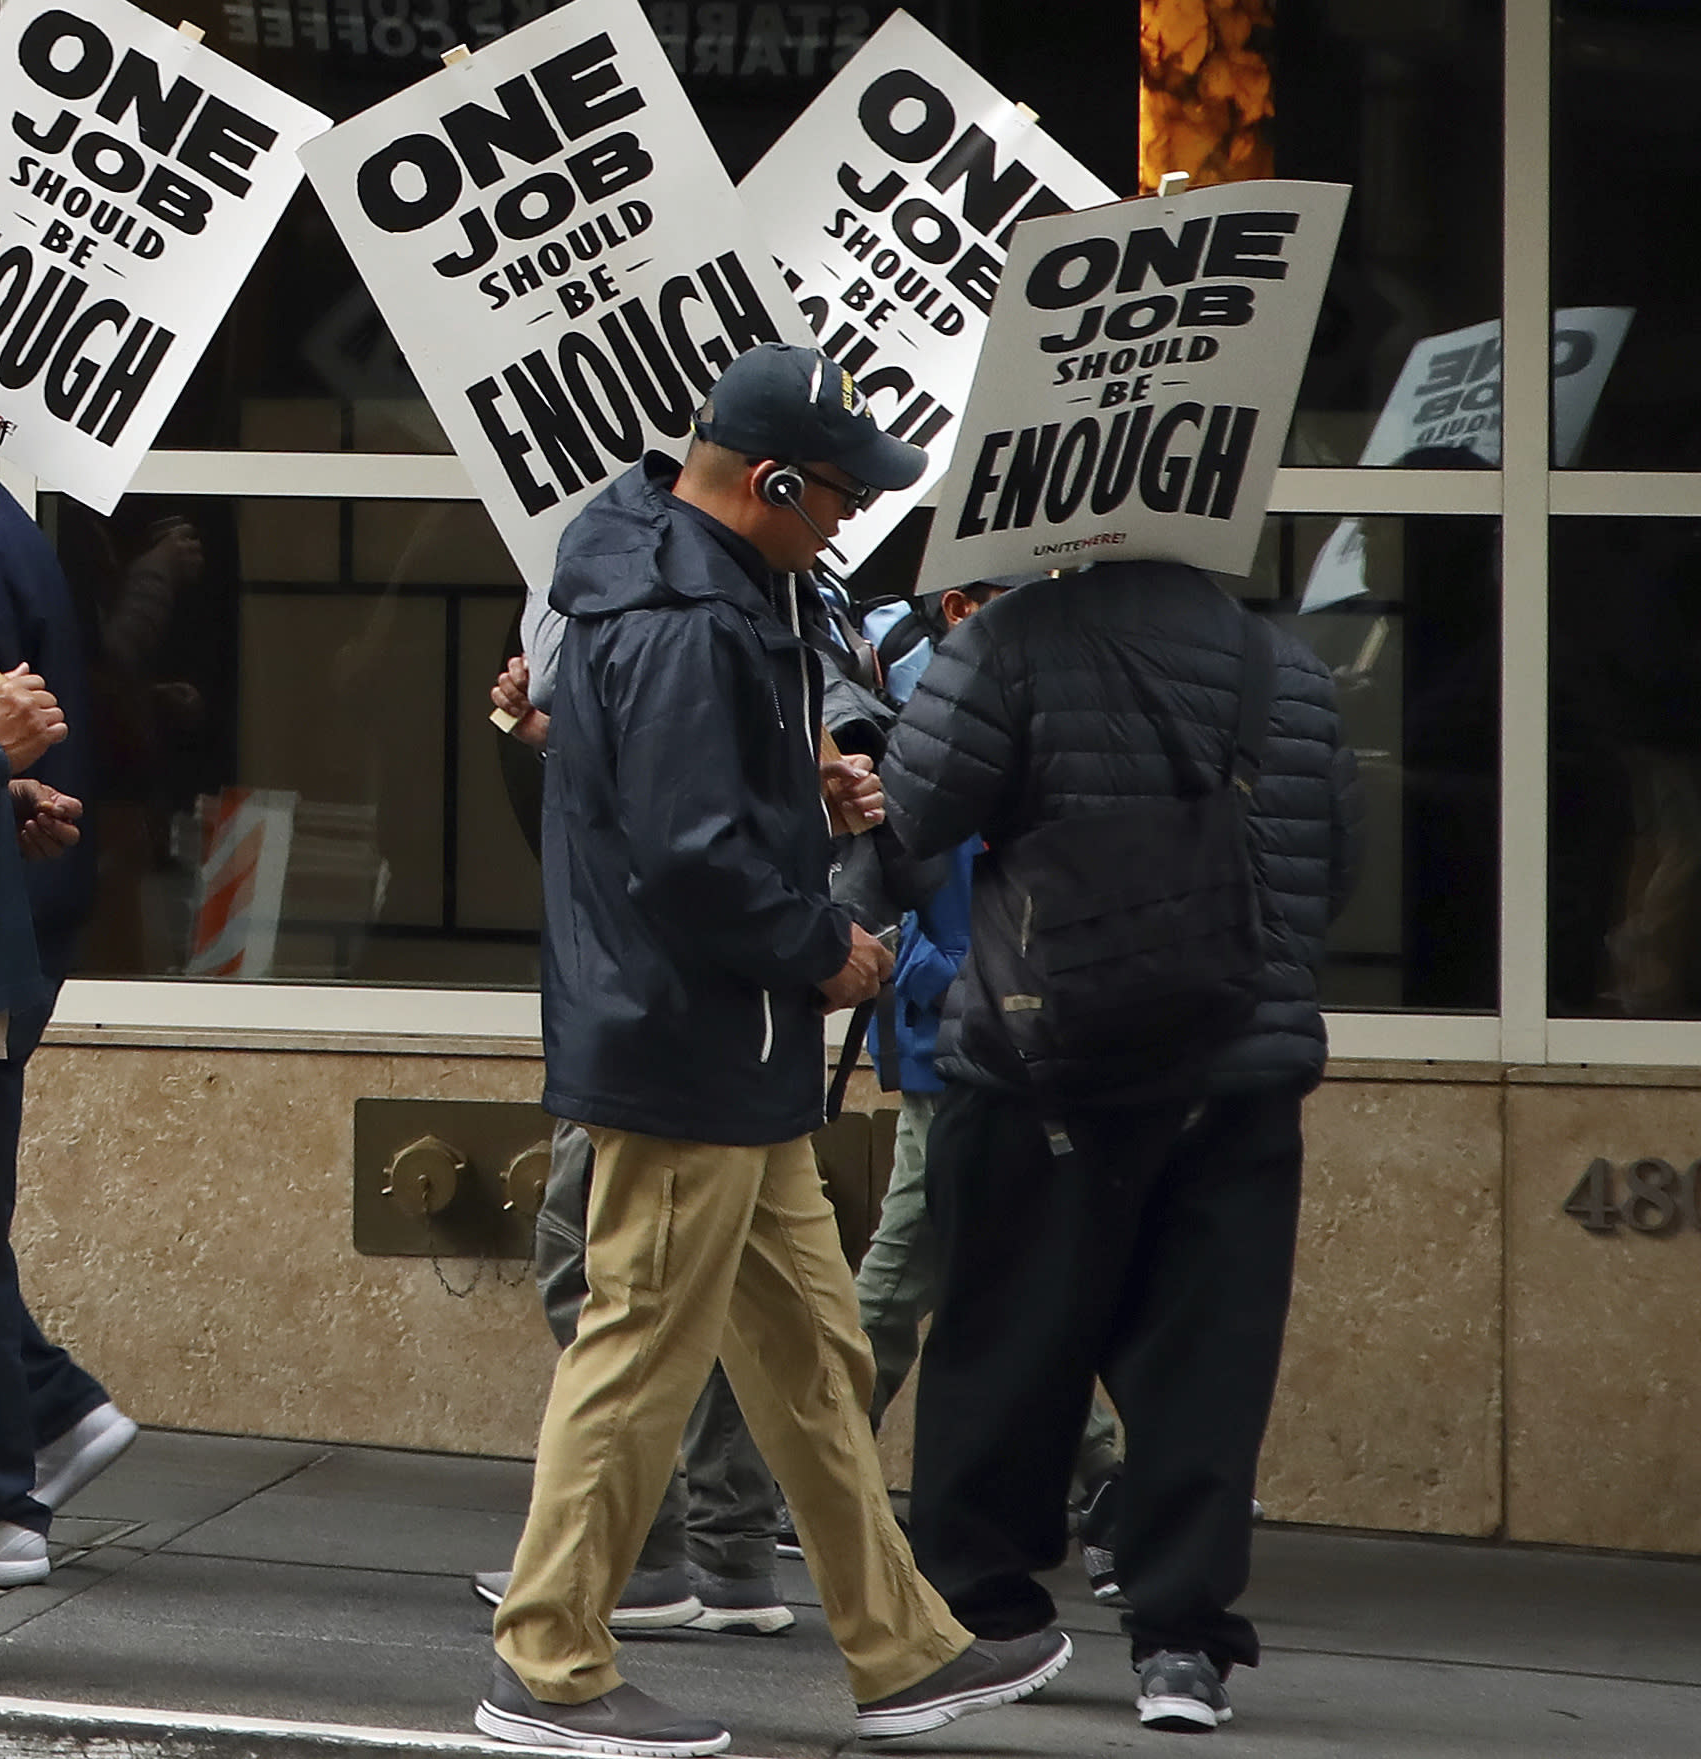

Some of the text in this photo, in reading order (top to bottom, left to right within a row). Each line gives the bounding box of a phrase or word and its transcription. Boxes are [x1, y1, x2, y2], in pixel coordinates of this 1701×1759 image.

[19, 10, 278, 199] ONE
[357, 32, 646, 233] ONE
[10, 157, 164, 259] SHOULD
[12, 110, 212, 235] JOB
[433, 132, 653, 278] JOB
[858, 69, 1075, 251] ON
[40, 219, 98, 269] BE
[479, 201, 652, 310] SHOULD
[557, 264, 620, 319] BE
[824, 209, 964, 336] SHOULD
[1026, 212, 1300, 310] ONE
[841, 277, 897, 331] BE
[1040, 285, 1255, 353] JOB
[1053, 336, 1219, 385] SHOULD
[1099, 374, 1153, 408] BE
[955, 402, 1259, 540] ENOUGH
[1563, 1157, 1701, 1238] 48
